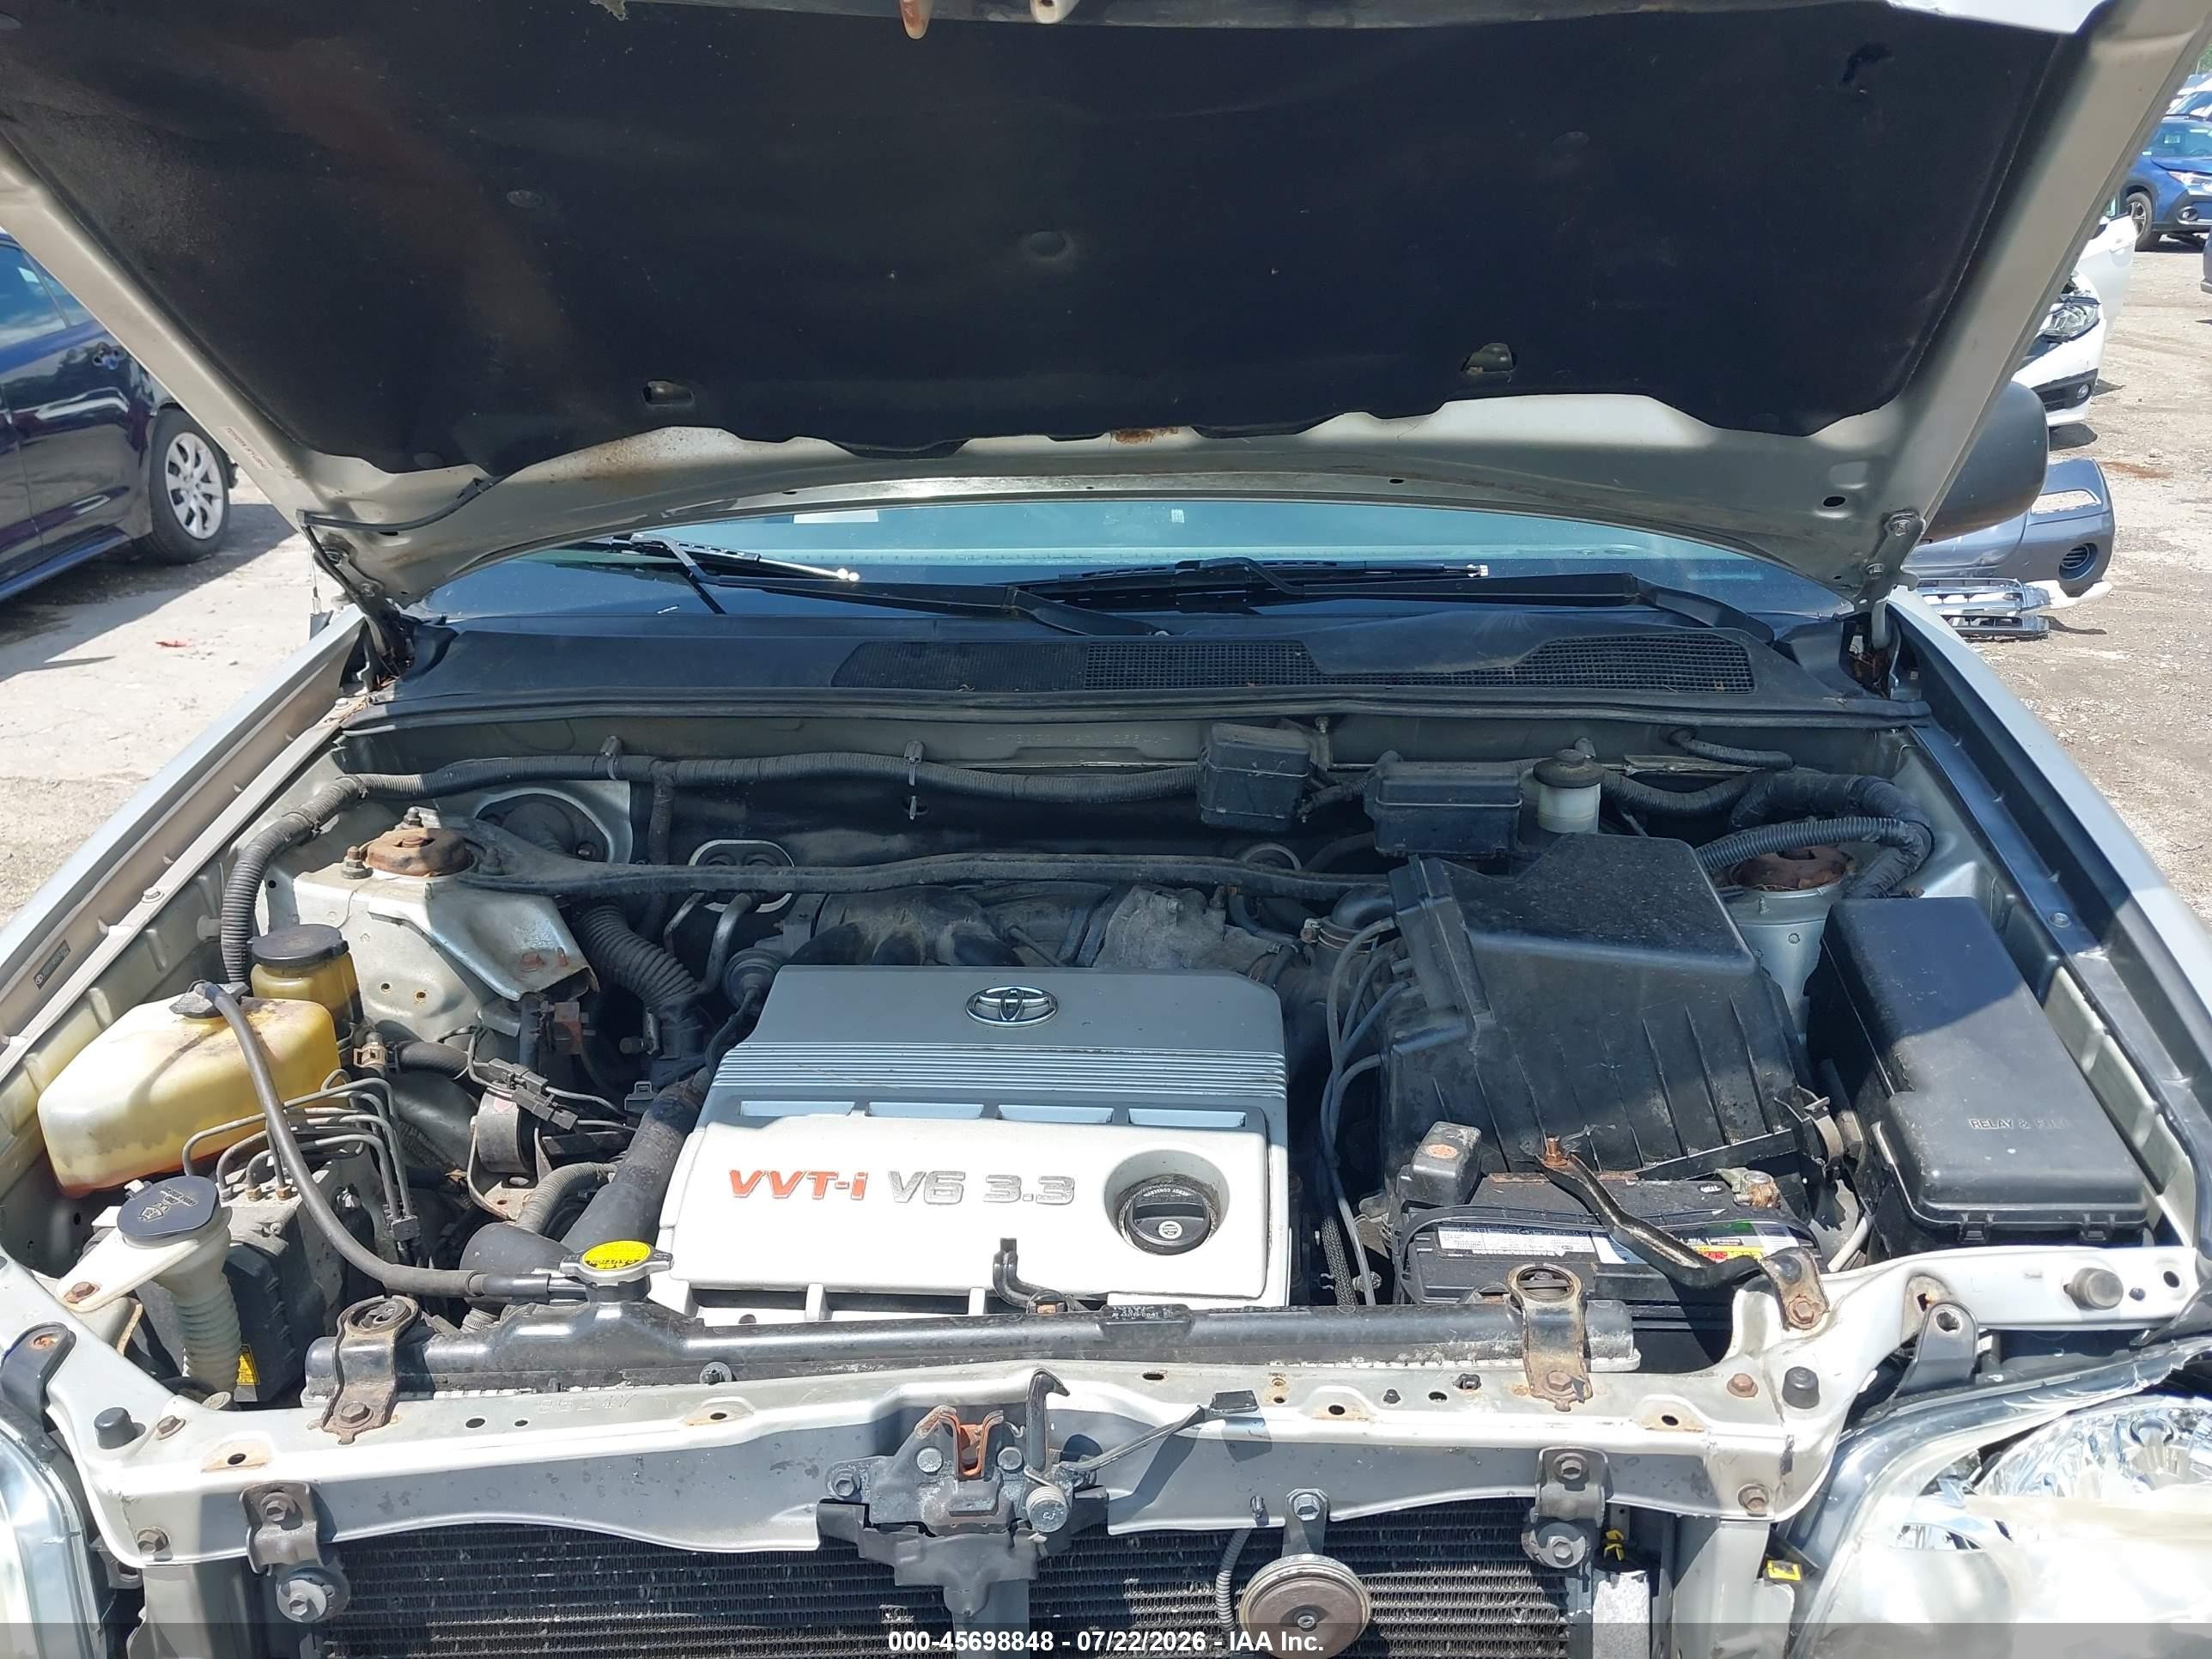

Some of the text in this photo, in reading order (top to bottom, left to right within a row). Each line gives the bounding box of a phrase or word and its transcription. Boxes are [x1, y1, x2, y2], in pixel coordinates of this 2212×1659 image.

[1969, 1118, 2014, 1130] RELAY
[729, 1170, 1075, 1206] VVT-i V6 3.3
